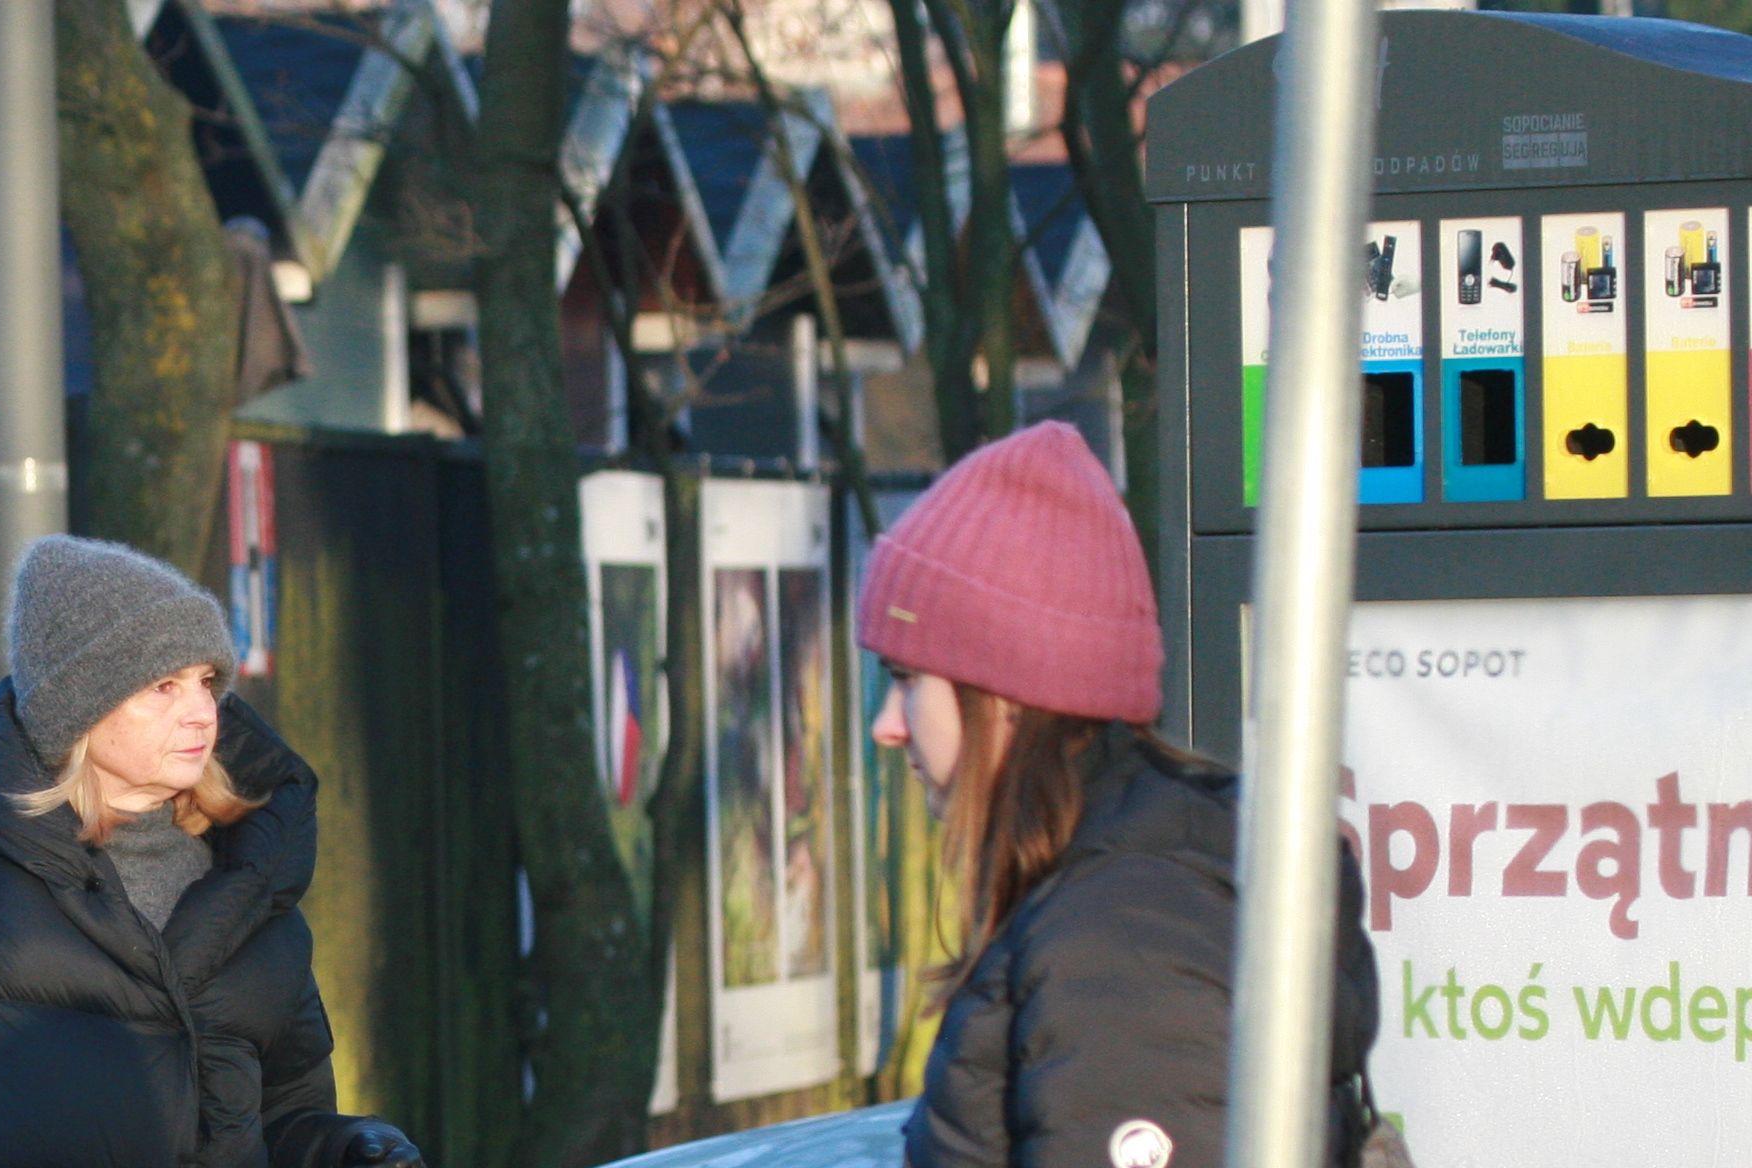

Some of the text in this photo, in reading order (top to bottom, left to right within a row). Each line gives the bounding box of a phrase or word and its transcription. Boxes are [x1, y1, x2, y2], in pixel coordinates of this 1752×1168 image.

[1503, 113, 1585, 132] SOPOCIANIE
[1186, 149, 1481, 182] PUNKT ODPADÓW
[1362, 331, 1409, 344] Drobna
[1458, 328, 1516, 343] Telefony
[1345, 649, 1526, 678] ECO SOPOT
[1401, 959, 1549, 1042] ktoś
